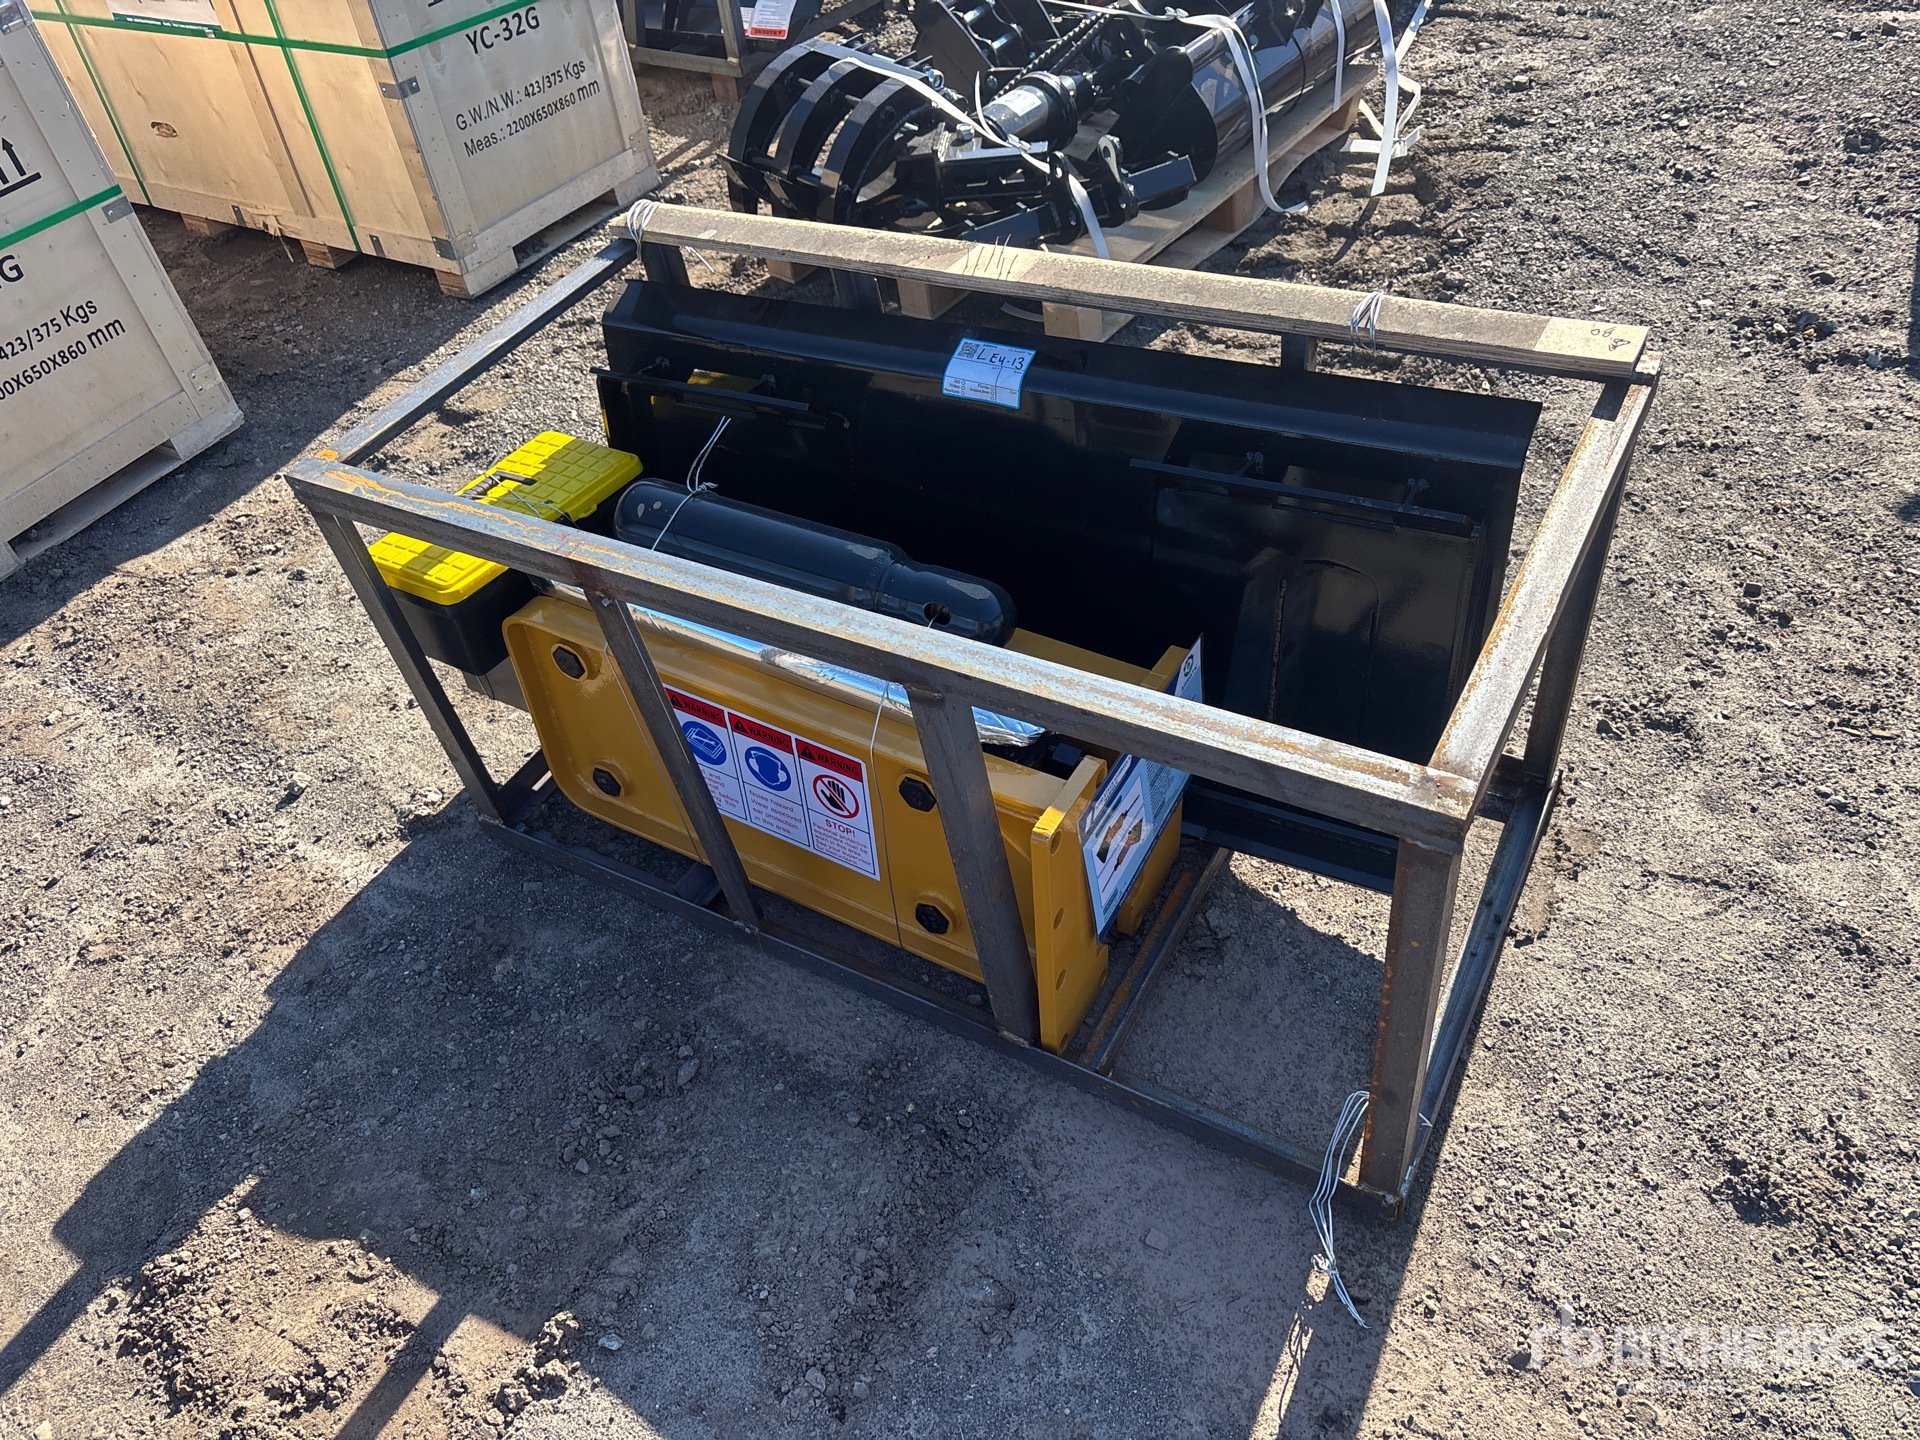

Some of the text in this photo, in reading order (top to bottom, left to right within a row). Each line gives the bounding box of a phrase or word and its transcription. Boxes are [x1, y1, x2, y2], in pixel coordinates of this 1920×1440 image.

[465, 6, 540, 54] YC-32G
[455, 60, 586, 131] G.W./N.W.: 423/375 Kgs
[463, 80, 600, 157] Meas.: 2200X650X860 mm
[0, 254, 24, 288] G
[0, 300, 98, 362] 423/375 Kgs
[87, 319, 126, 349] mm
[684, 700, 723, 722] WARNING
[748, 725, 790, 749] WARNING
[816, 751, 859, 776] WARNING
[825, 819, 856, 838] STOP!
